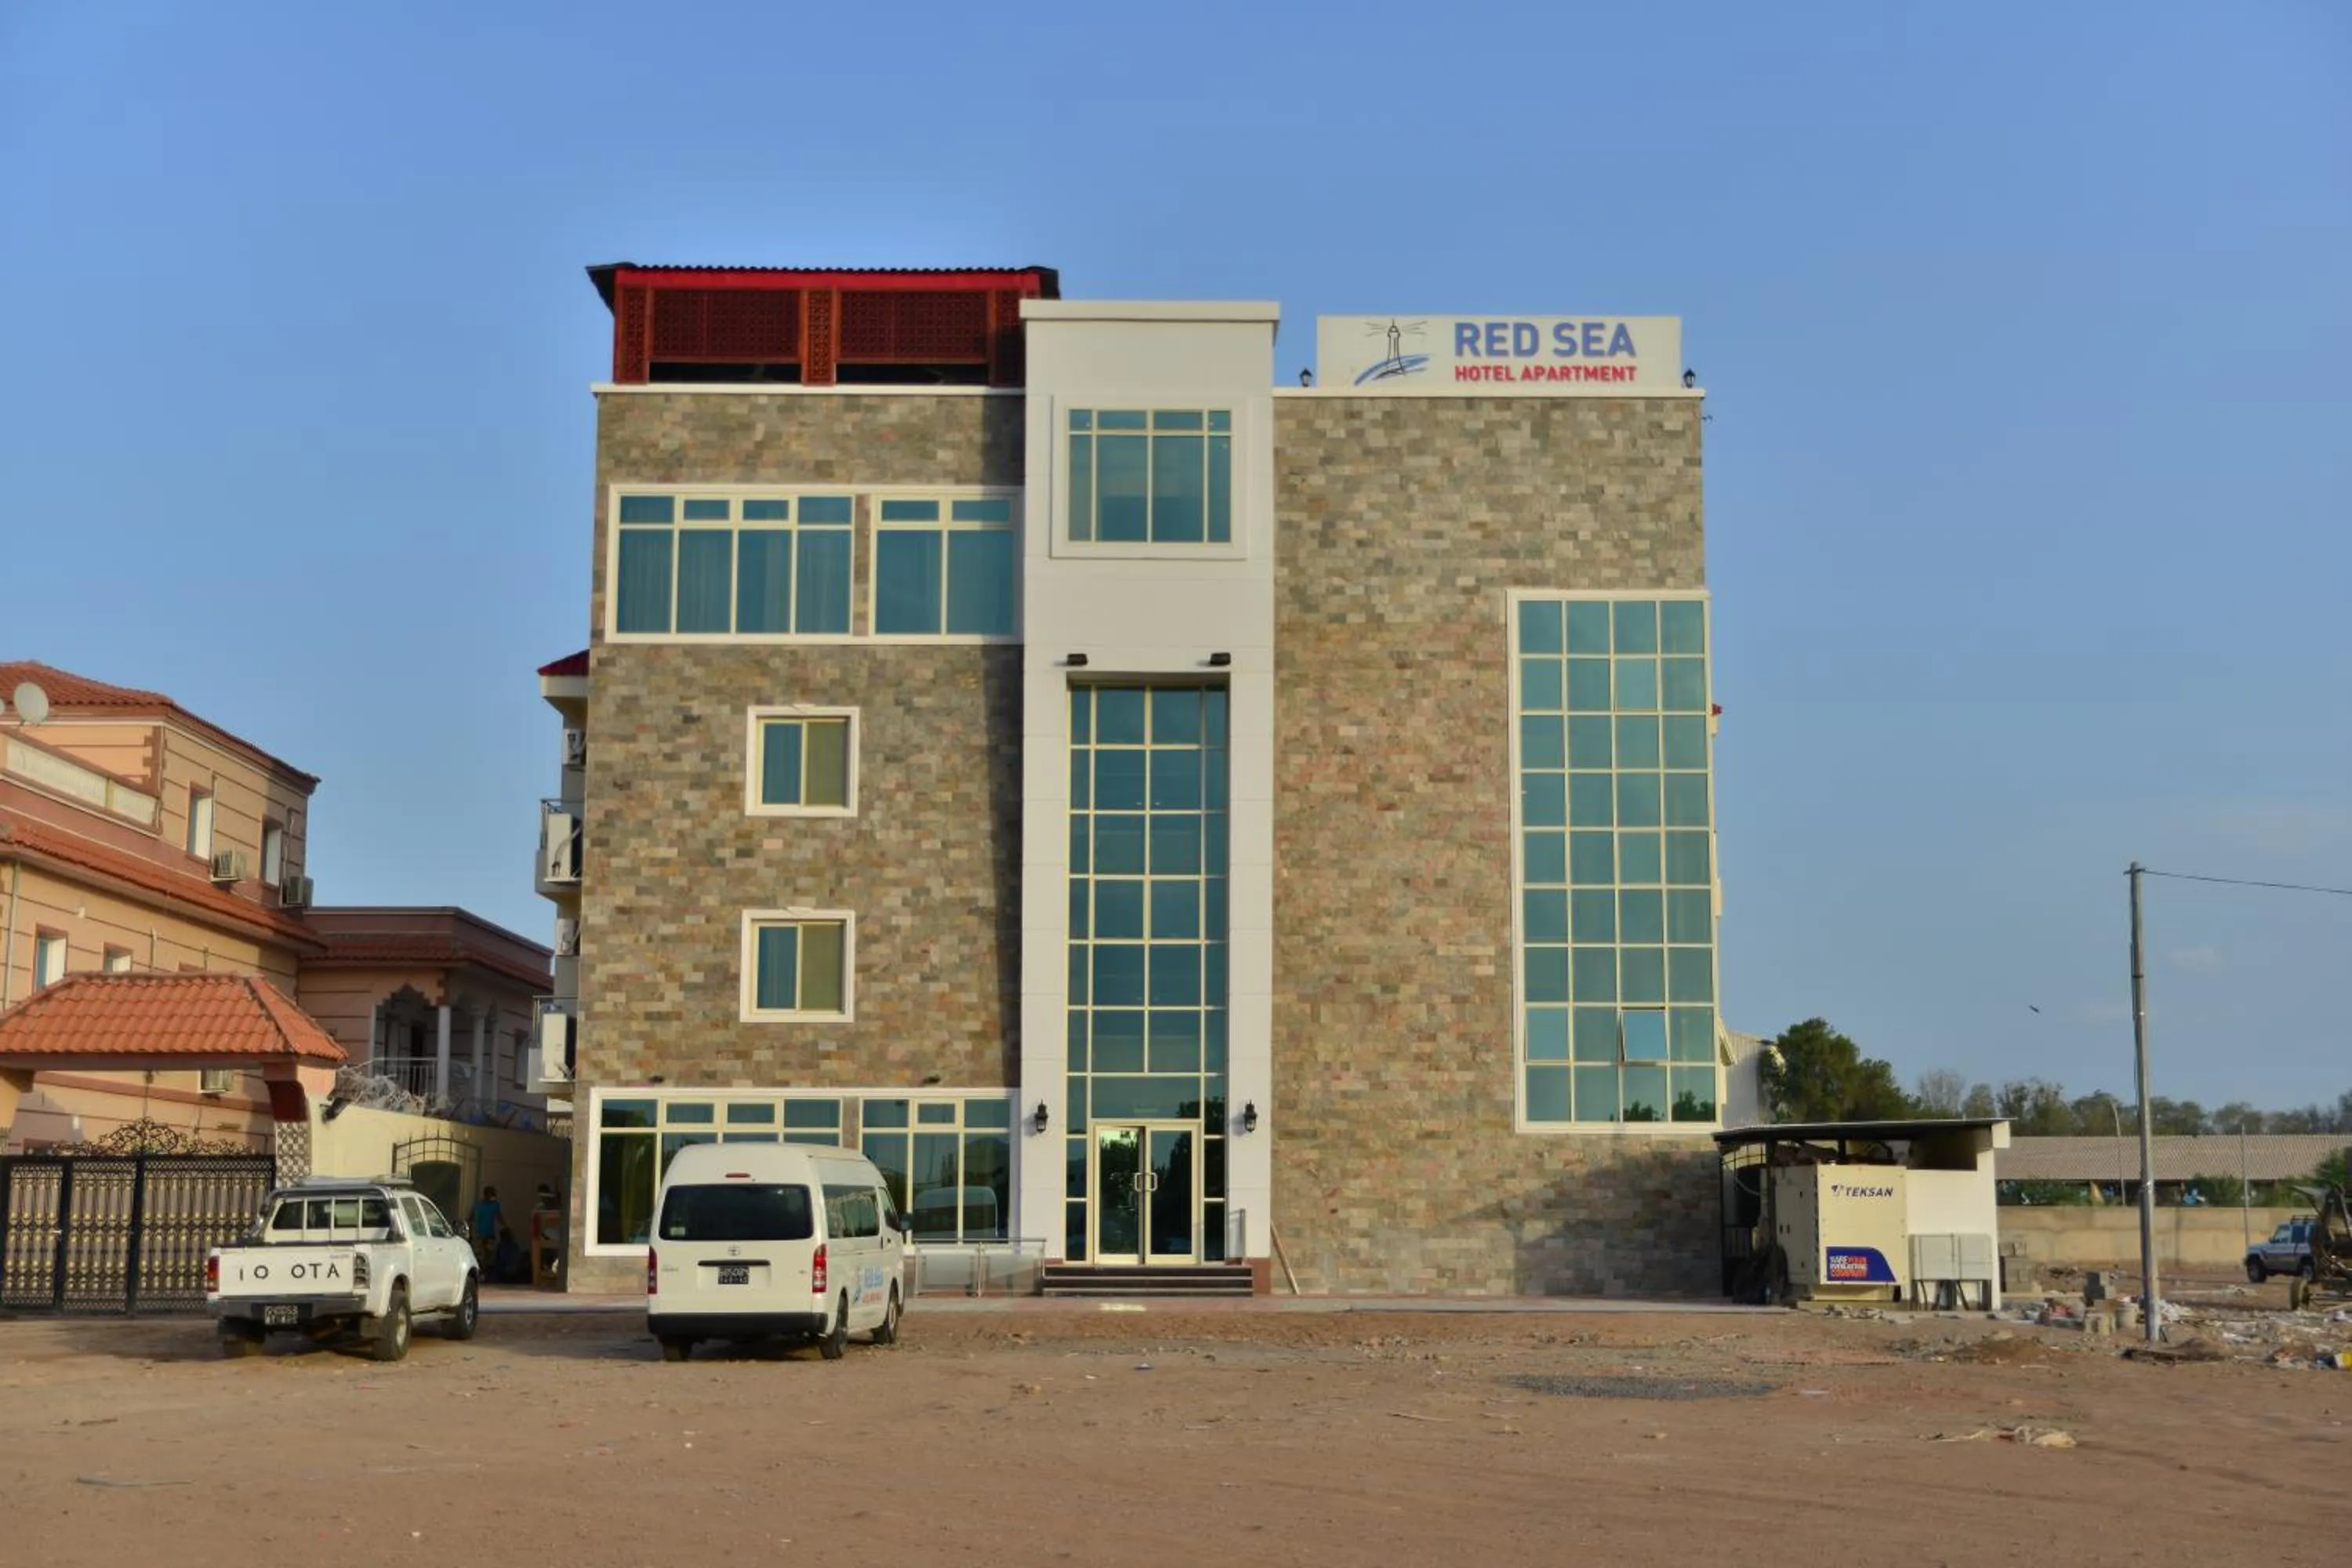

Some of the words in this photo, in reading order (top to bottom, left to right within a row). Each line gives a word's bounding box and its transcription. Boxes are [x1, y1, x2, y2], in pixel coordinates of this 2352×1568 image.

[1454, 322, 1539, 358] RED
[1552, 322, 1636, 358] SEA
[1454, 365, 1515, 381] HOTEL
[1521, 365, 1637, 381] APARTMENT
[1846, 1185, 1893, 1197] TEKSAN
